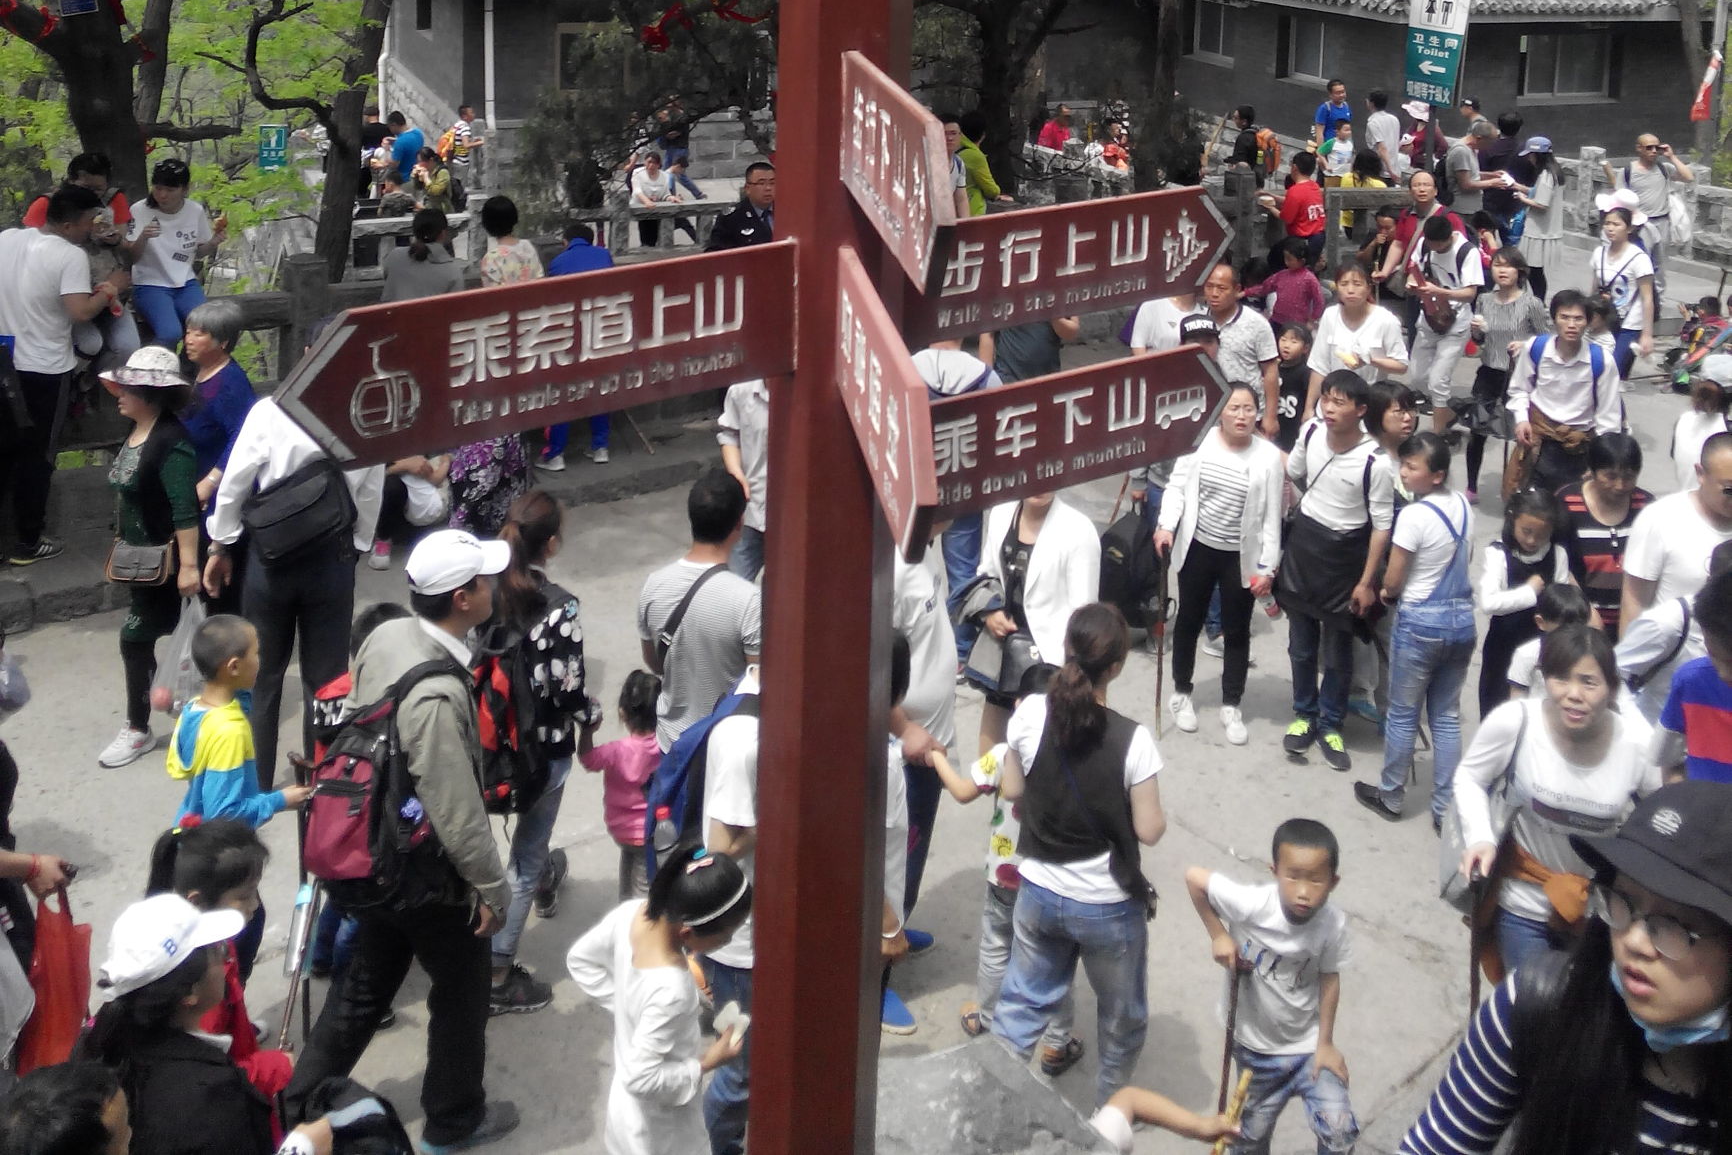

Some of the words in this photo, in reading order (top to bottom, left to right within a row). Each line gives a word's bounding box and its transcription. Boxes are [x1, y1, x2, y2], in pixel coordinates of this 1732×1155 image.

[1412, 33, 1459, 50] 卫生间
[1417, 46, 1450, 59] Toilet
[941, 213, 1150, 298] 步行上山
[449, 275, 744, 388] 乘索道上山
[938, 302, 980, 328] Walk
[992, 302, 1014, 321] up
[1025, 292, 1056, 312] the
[1065, 275, 1147, 304] mountain
[451, 399, 494, 427] Take
[517, 385, 561, 414] cable
[567, 380, 594, 403] car
[624, 368, 644, 390] to
[650, 361, 675, 385] the
[681, 346, 744, 377] mountain
[935, 377, 1147, 477] 乘车下山
[981, 470, 1028, 495] down
[1037, 459, 1064, 480] the
[1073, 437, 1146, 470] mountain
